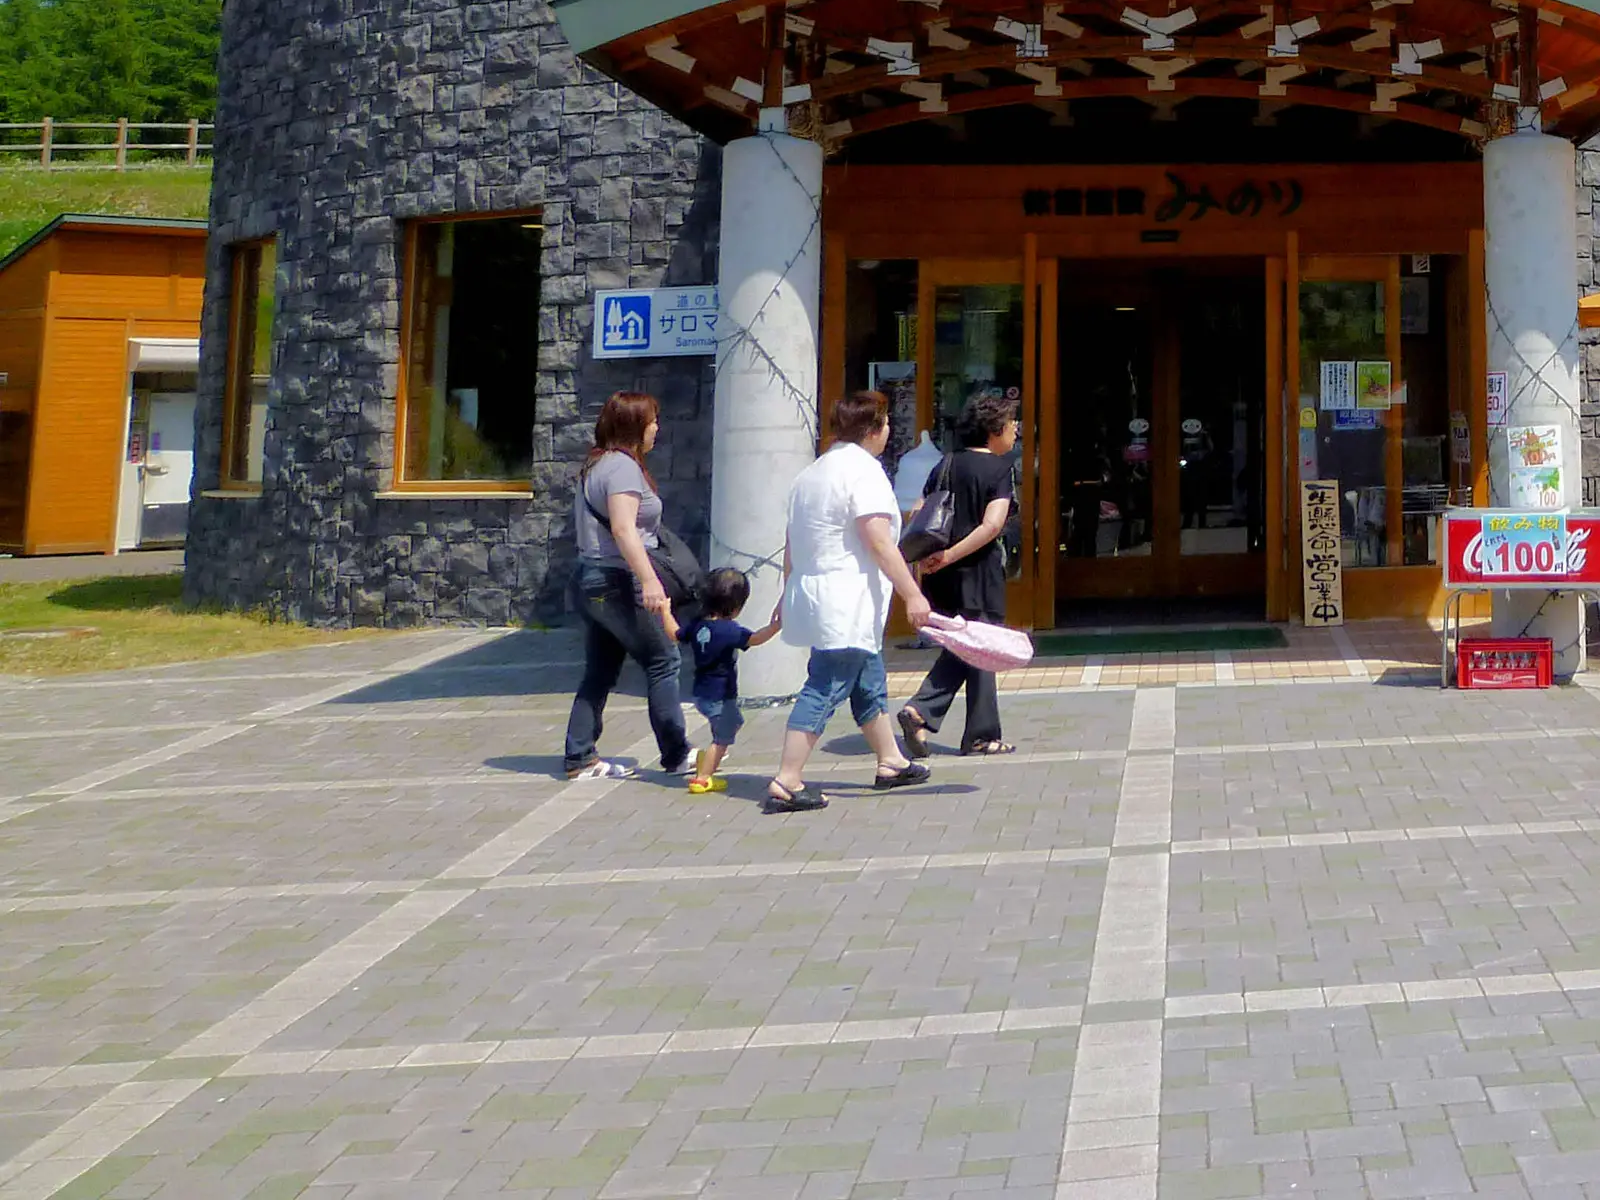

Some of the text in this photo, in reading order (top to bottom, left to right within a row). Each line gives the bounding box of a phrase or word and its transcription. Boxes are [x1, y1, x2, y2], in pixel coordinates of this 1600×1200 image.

[1154, 170, 1302, 222] みのり
[660, 314, 718, 334] サロマ
[1489, 516, 1560, 531] 飲み物
[1304, 484, 1340, 622] 一生懸命営業中
